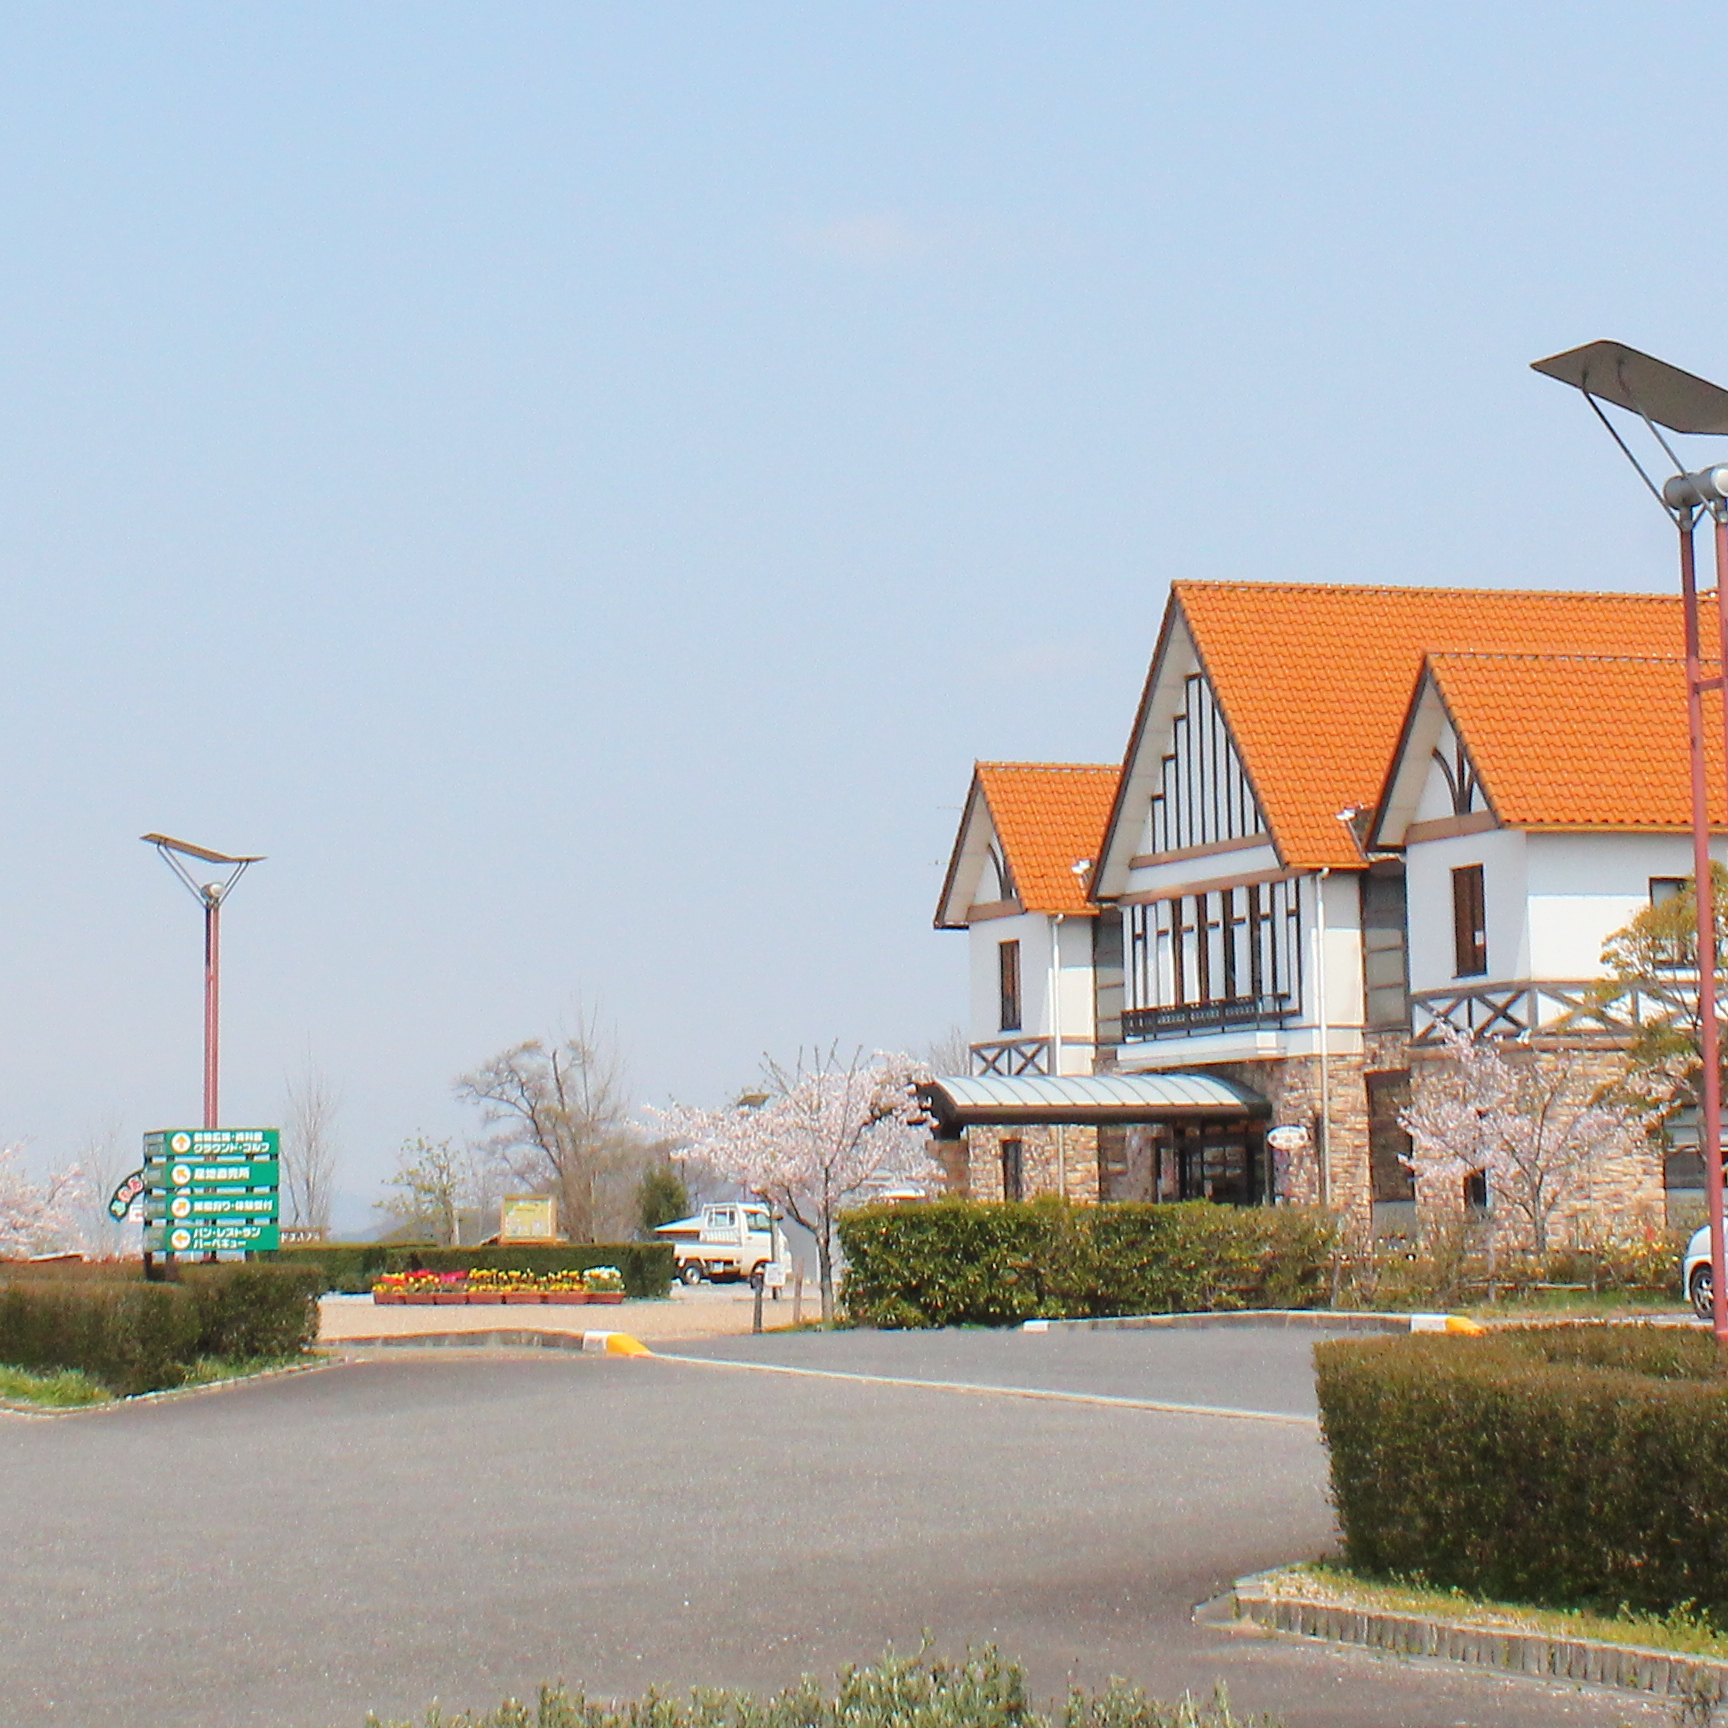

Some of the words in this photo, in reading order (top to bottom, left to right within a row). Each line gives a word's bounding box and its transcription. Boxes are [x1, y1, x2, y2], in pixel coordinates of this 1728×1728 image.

[193, 1228, 261, 1238] パン・レストラン
